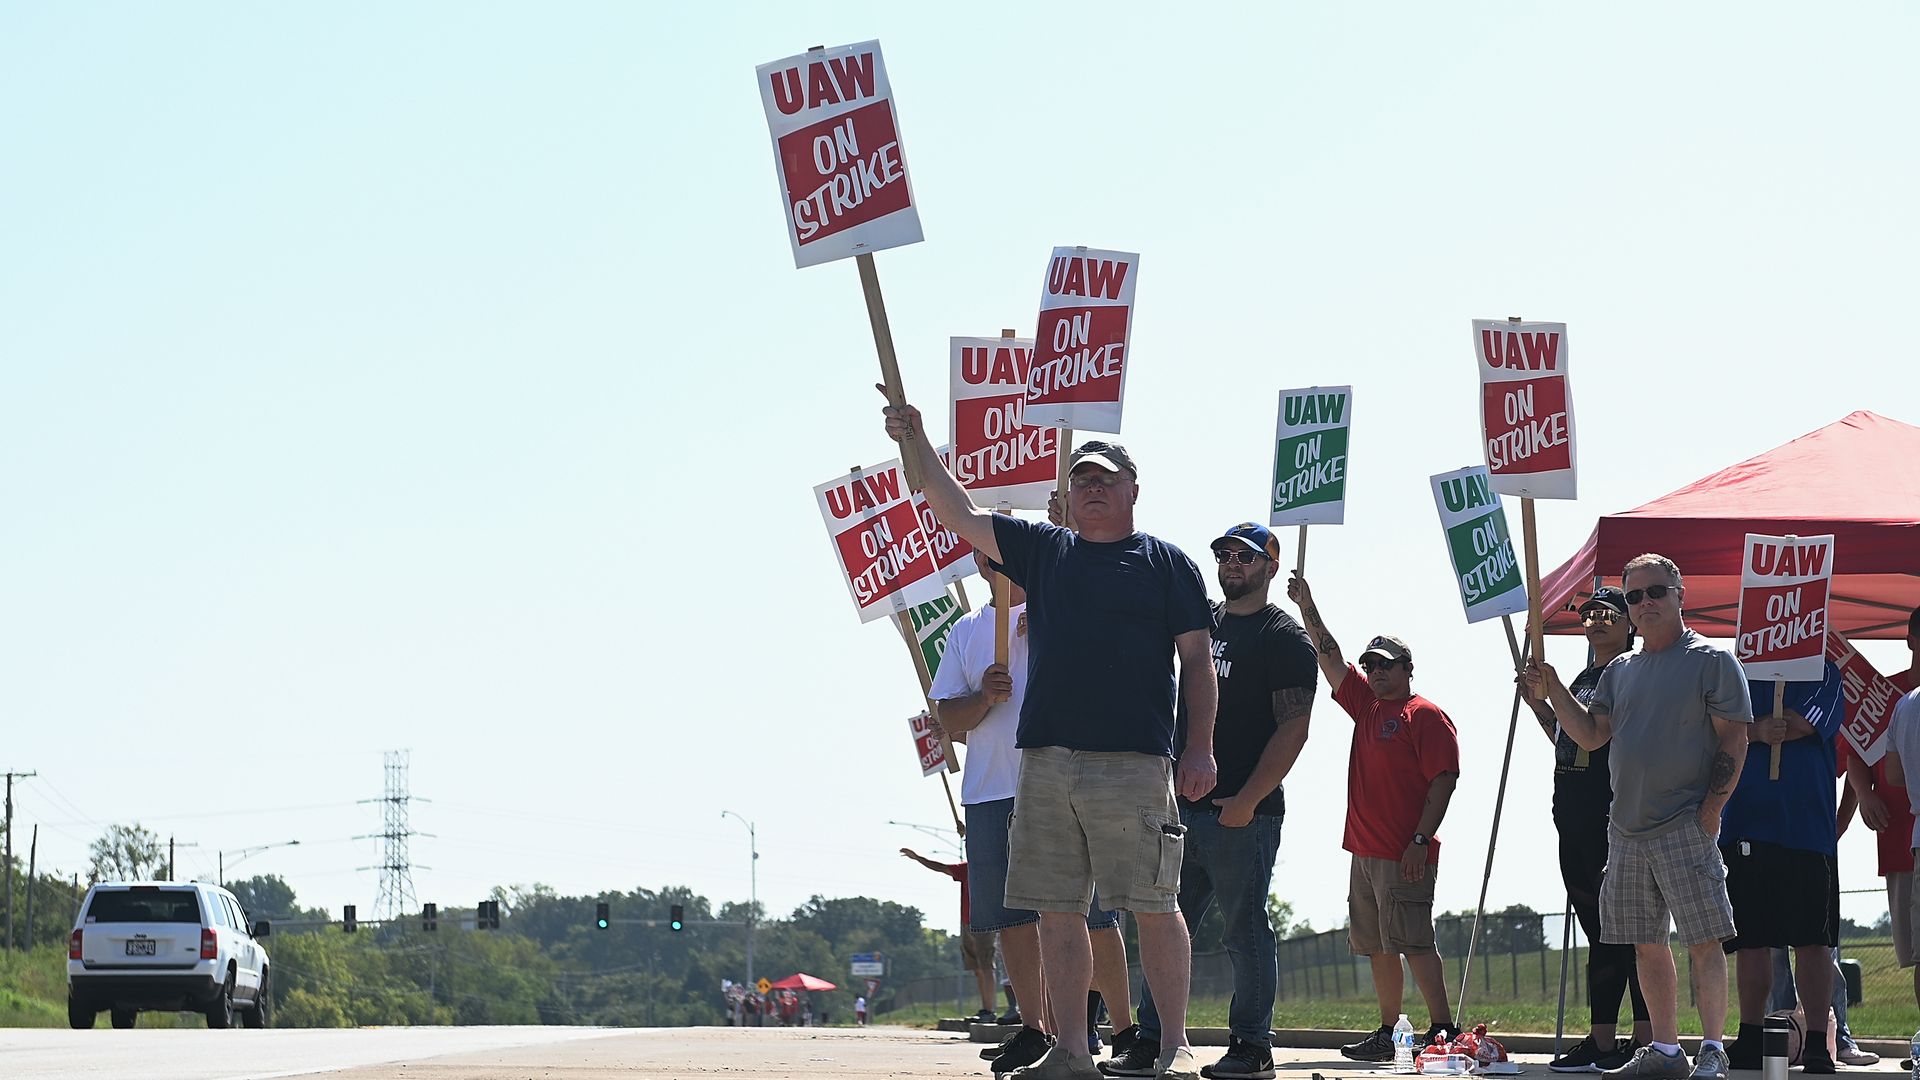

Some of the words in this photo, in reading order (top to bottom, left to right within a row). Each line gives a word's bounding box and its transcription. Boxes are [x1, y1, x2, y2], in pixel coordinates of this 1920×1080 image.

[770, 52, 875, 115] UAW
[813, 117, 859, 175] ON
[793, 141, 904, 240] STRIKE
[1048, 256, 1129, 300] UAW
[1053, 311, 1092, 353] ON
[1481, 329, 1560, 371] UAW
[1027, 343, 1124, 401] STRIKE
[983, 397, 1023, 440] ON
[1284, 393, 1346, 427] UAW
[1504, 384, 1534, 426] ON
[956, 426, 1056, 486] STRIKE
[1295, 434, 1322, 469] ON
[1487, 411, 1568, 471] STRIKE
[824, 467, 901, 520] UAW
[1275, 455, 1346, 509] STRIKE
[860, 515, 894, 559] ON
[1472, 516, 1499, 557] ON
[1751, 543, 1828, 576] UAW
[852, 526, 929, 605] STRIKE
[1462, 537, 1516, 603] STRIKE
[1765, 587, 1802, 622] ON
[1739, 607, 1825, 660] STRIKE
[1842, 666, 1866, 705] ON
[1848, 673, 1894, 748] STRIKE
